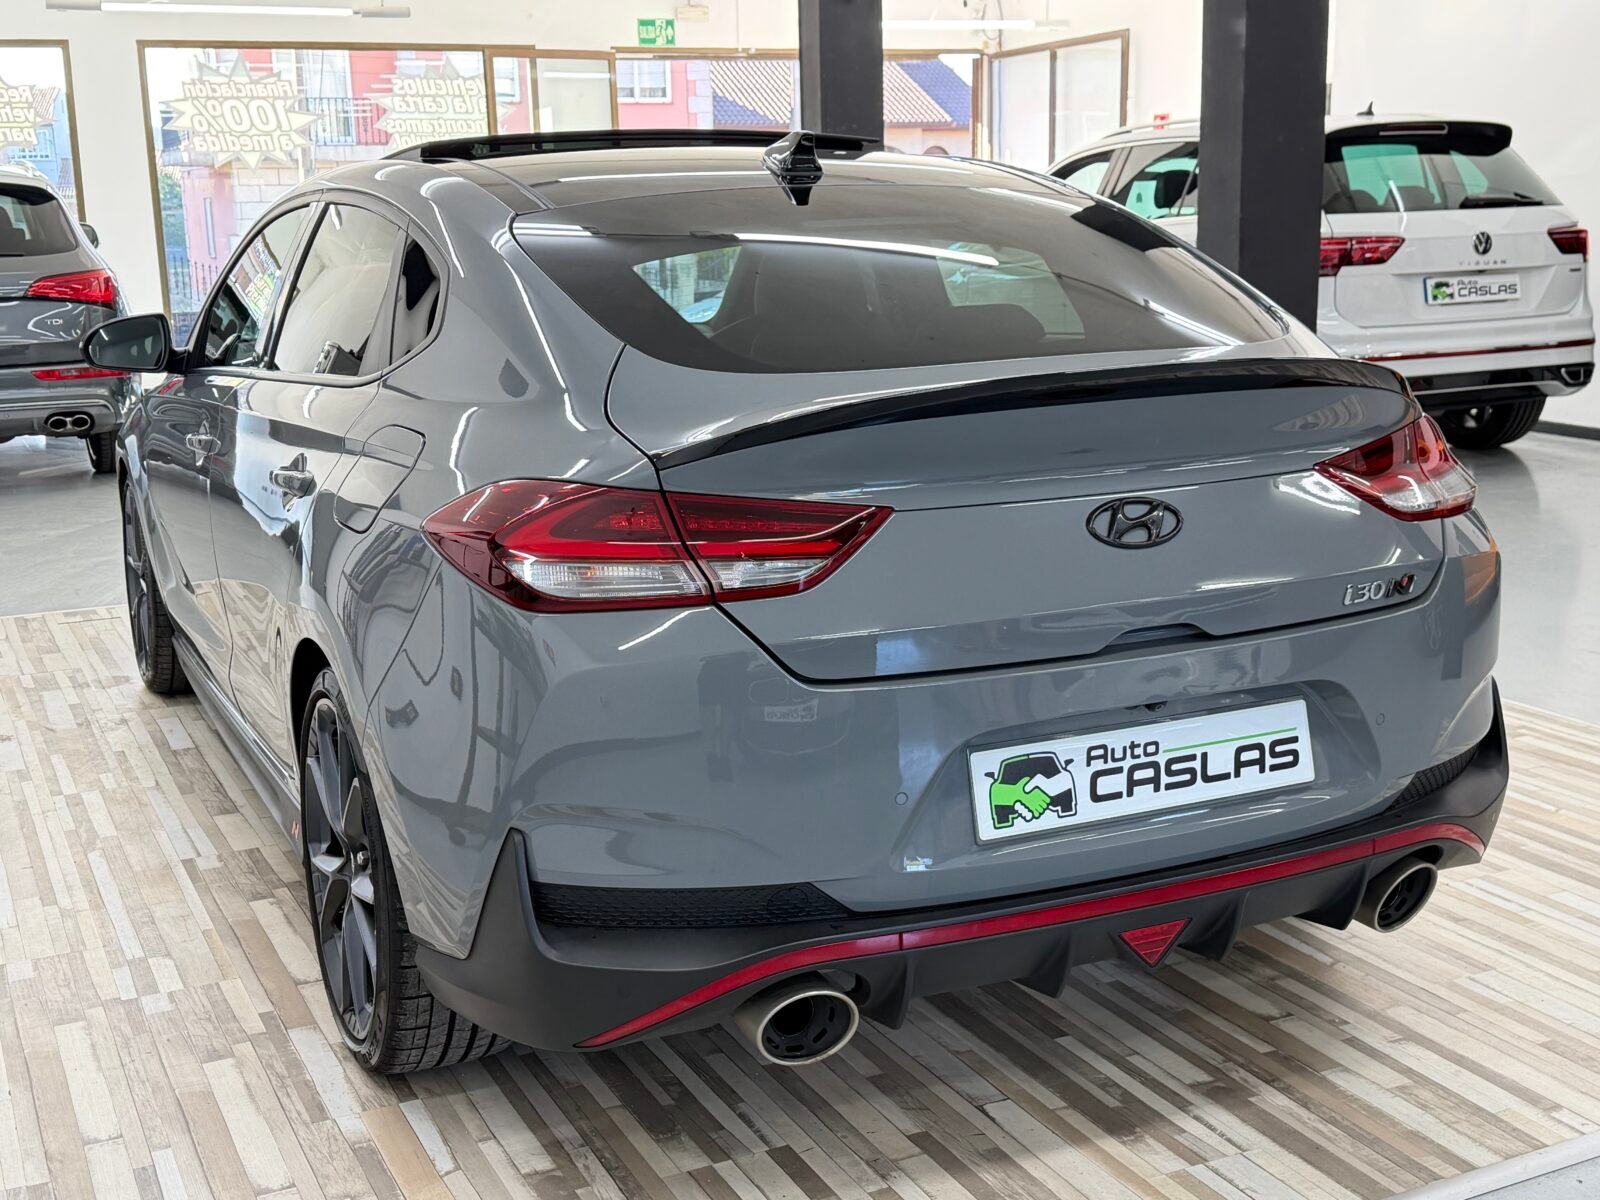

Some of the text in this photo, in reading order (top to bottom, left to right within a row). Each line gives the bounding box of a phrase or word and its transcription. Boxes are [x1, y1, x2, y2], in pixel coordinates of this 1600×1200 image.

[1458, 283, 1518, 297] CASLAS
[1086, 740, 1160, 768] Auto
[1089, 735, 1300, 803] CASLAS
